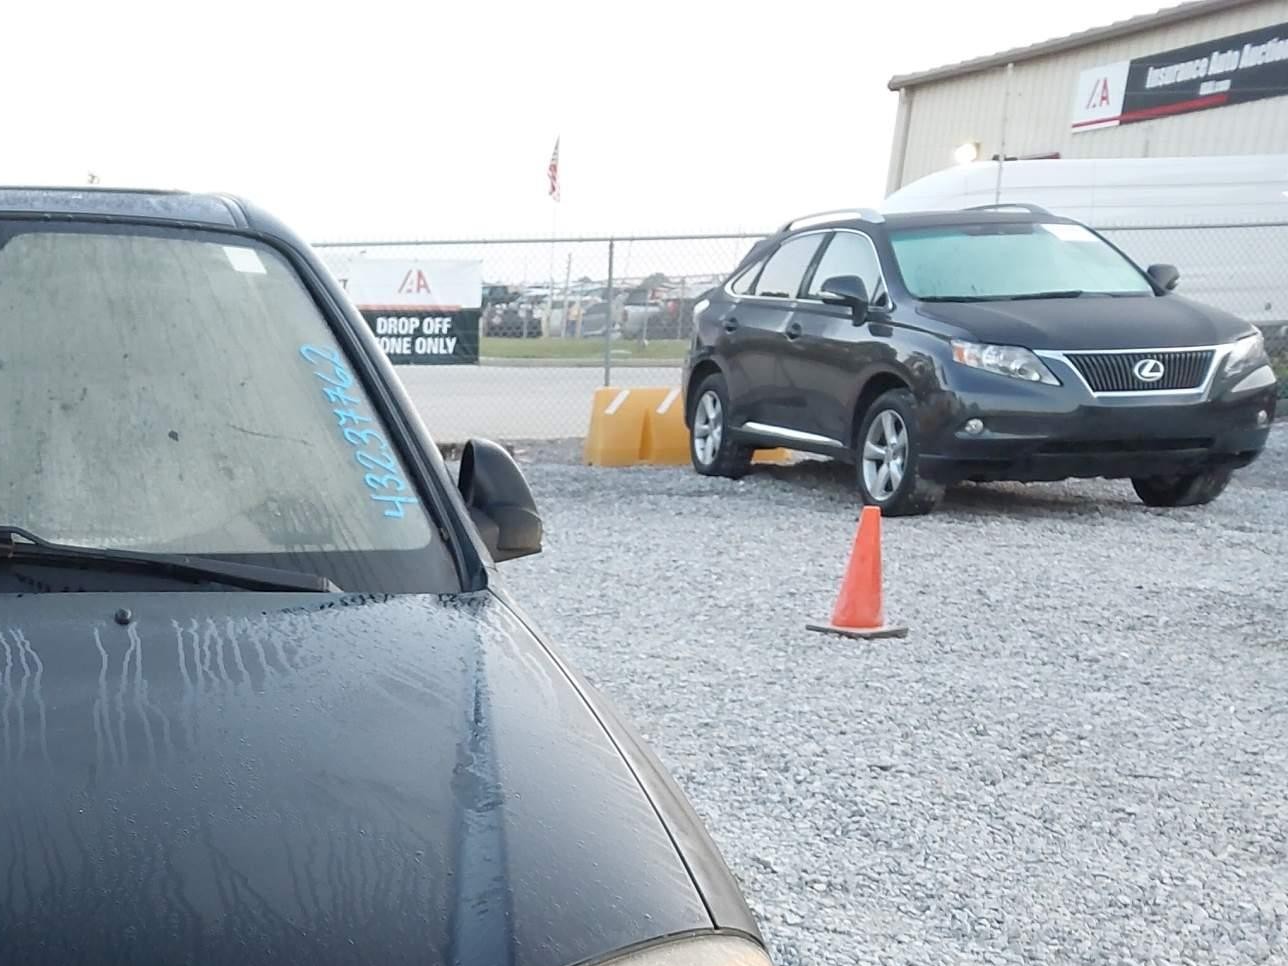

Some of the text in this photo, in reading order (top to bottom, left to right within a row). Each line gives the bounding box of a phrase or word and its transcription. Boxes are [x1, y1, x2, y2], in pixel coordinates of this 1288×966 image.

[376, 316, 452, 335] DROP OFF
[414, 336, 457, 355] ONLY
[299, 343, 418, 519] 43237762
